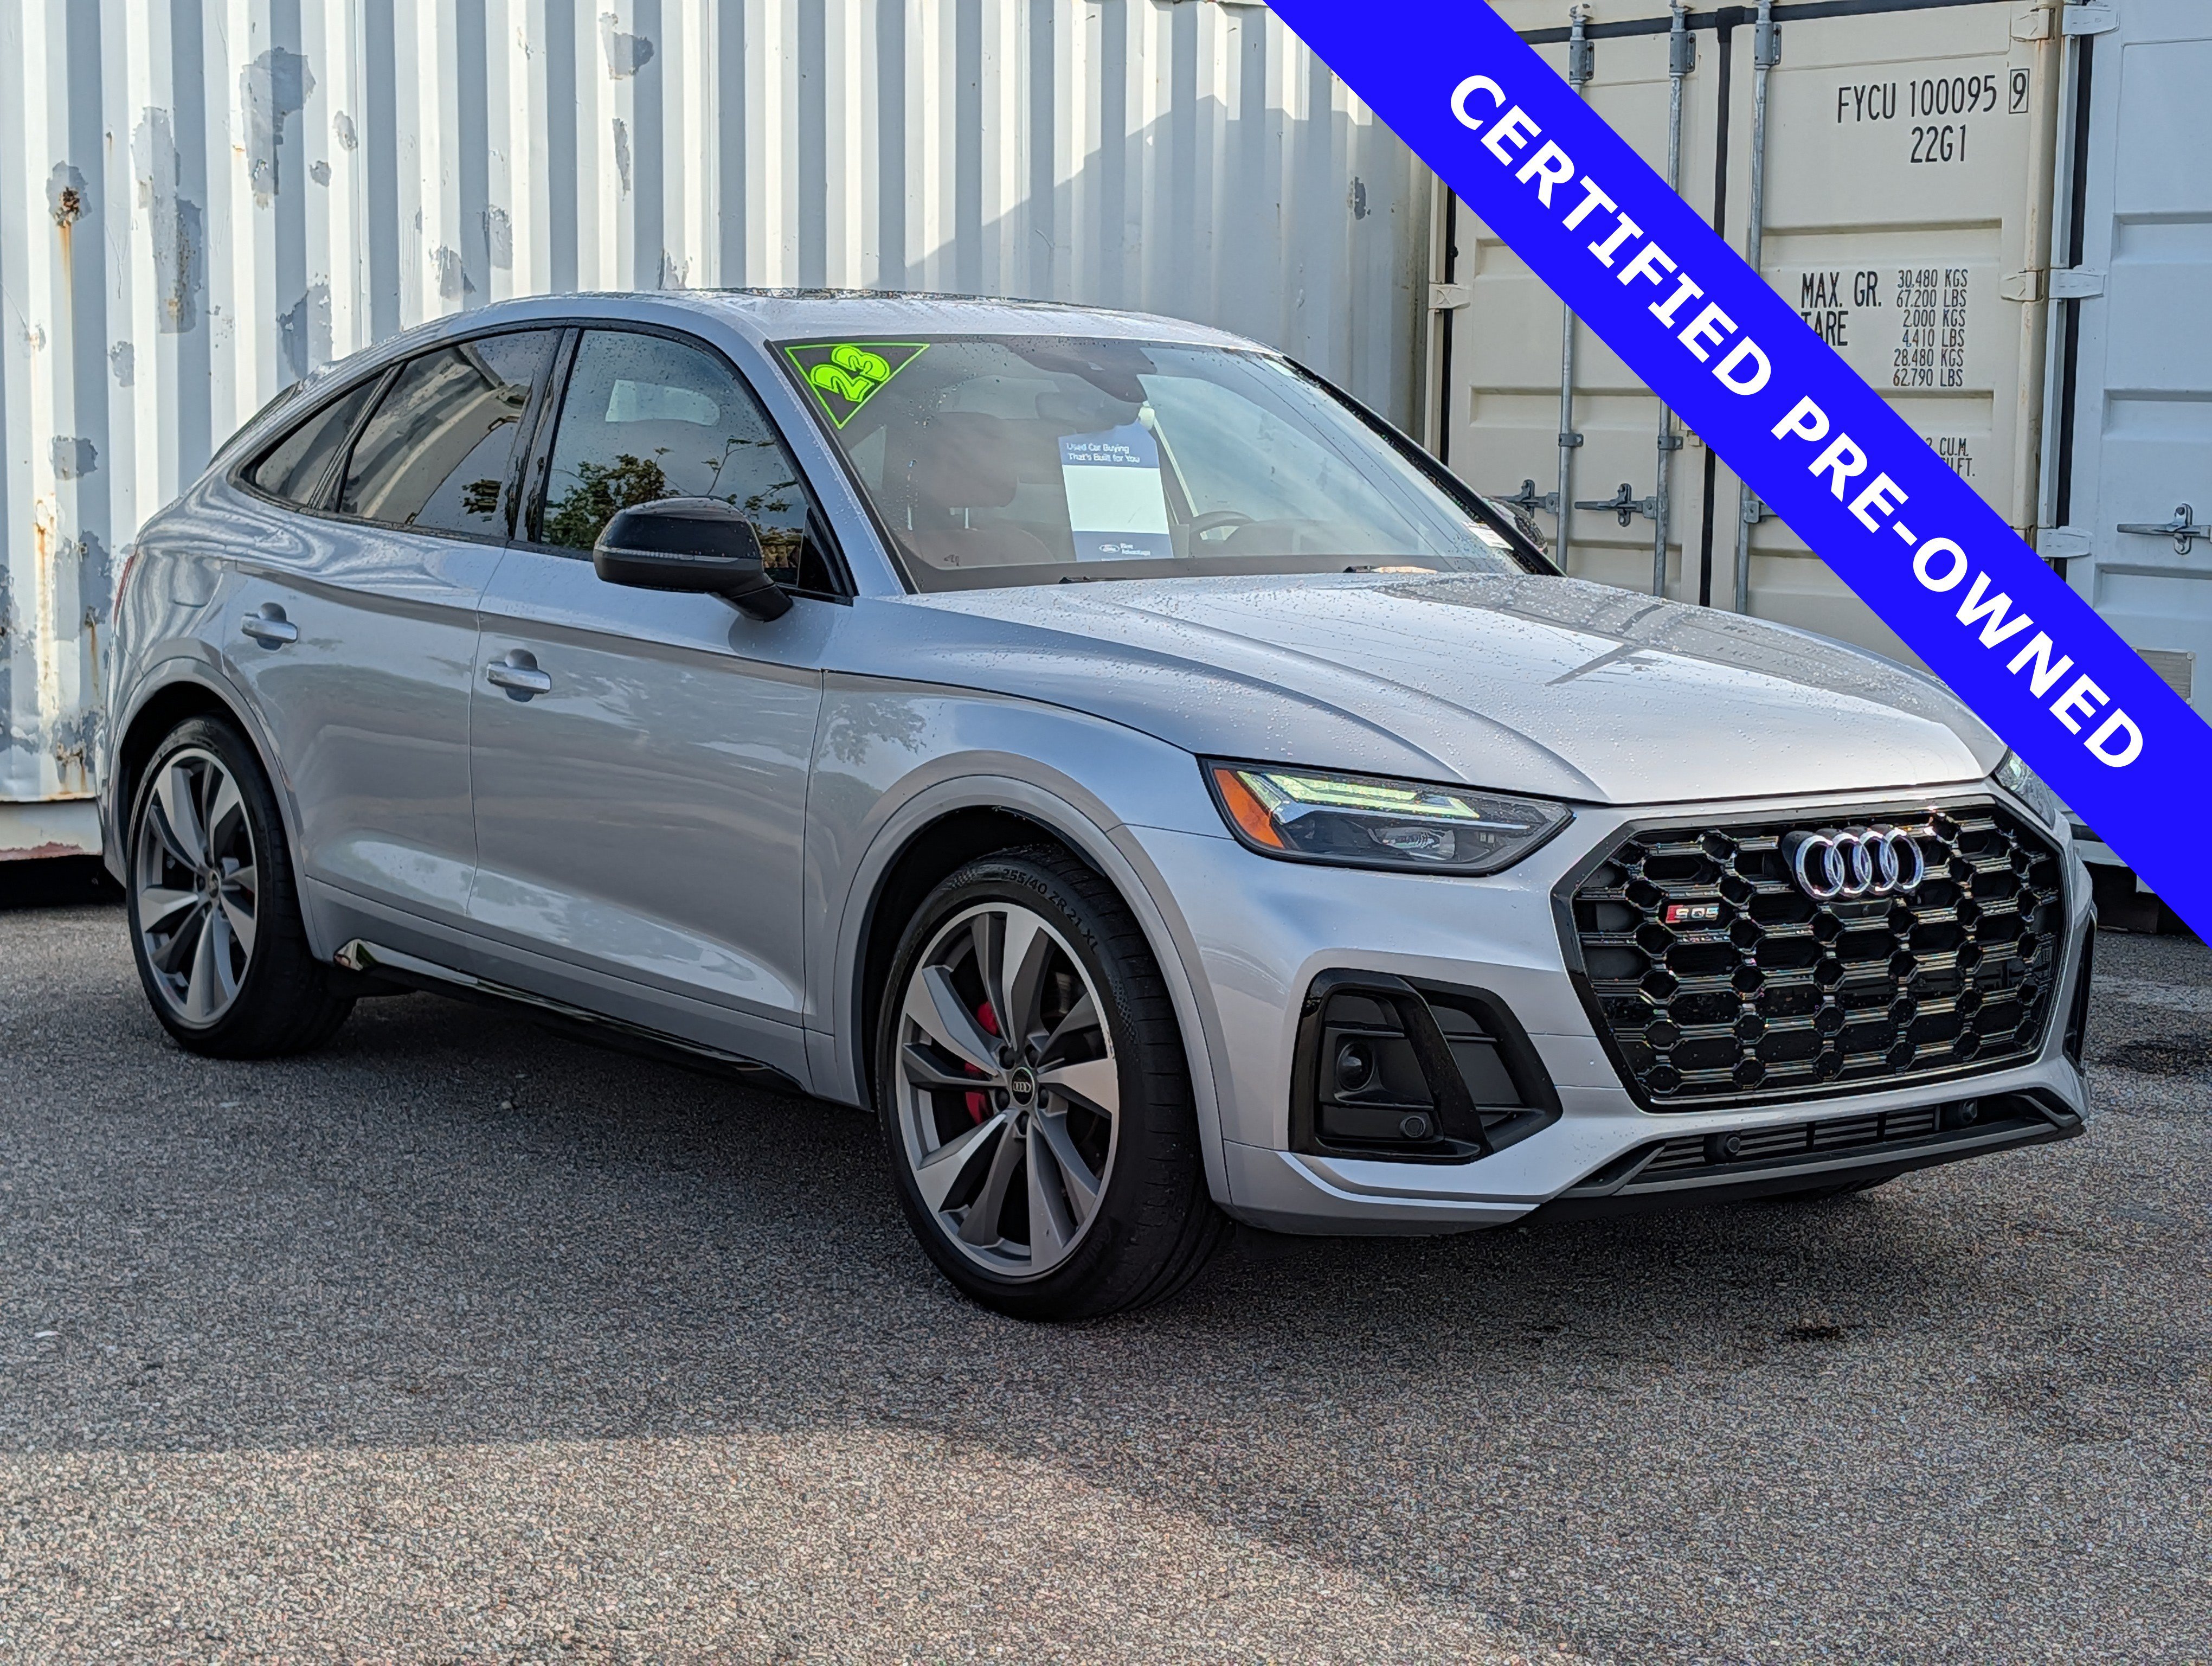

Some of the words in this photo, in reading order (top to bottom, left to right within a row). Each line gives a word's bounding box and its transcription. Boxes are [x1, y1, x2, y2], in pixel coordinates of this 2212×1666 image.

[1837, 82, 1896, 124] FYCU
[1909, 74, 1997, 118] 100095
[2012, 72, 2026, 111] 9
[1910, 124, 1966, 163] 22G1
[1801, 271, 1843, 308] MAX.
[1854, 271, 1882, 307] GR.
[1945, 269, 1969, 288] KGS
[1944, 289, 1967, 307] LBS
[1942, 308, 1966, 328] KGS
[1941, 328, 1965, 348] LBS
[1940, 348, 1964, 367] KGS
[810, 345, 890, 402] 23
[1940, 368, 1963, 387] LBS
[1113, 454, 1123, 462] for
[1125, 454, 1140, 463] You
[1002, 868, 1047, 895] 255/40
[1049, 890, 1068, 912] ZR
[1066, 908, 1082, 927] 21
[1083, 928, 1098, 955] XL
